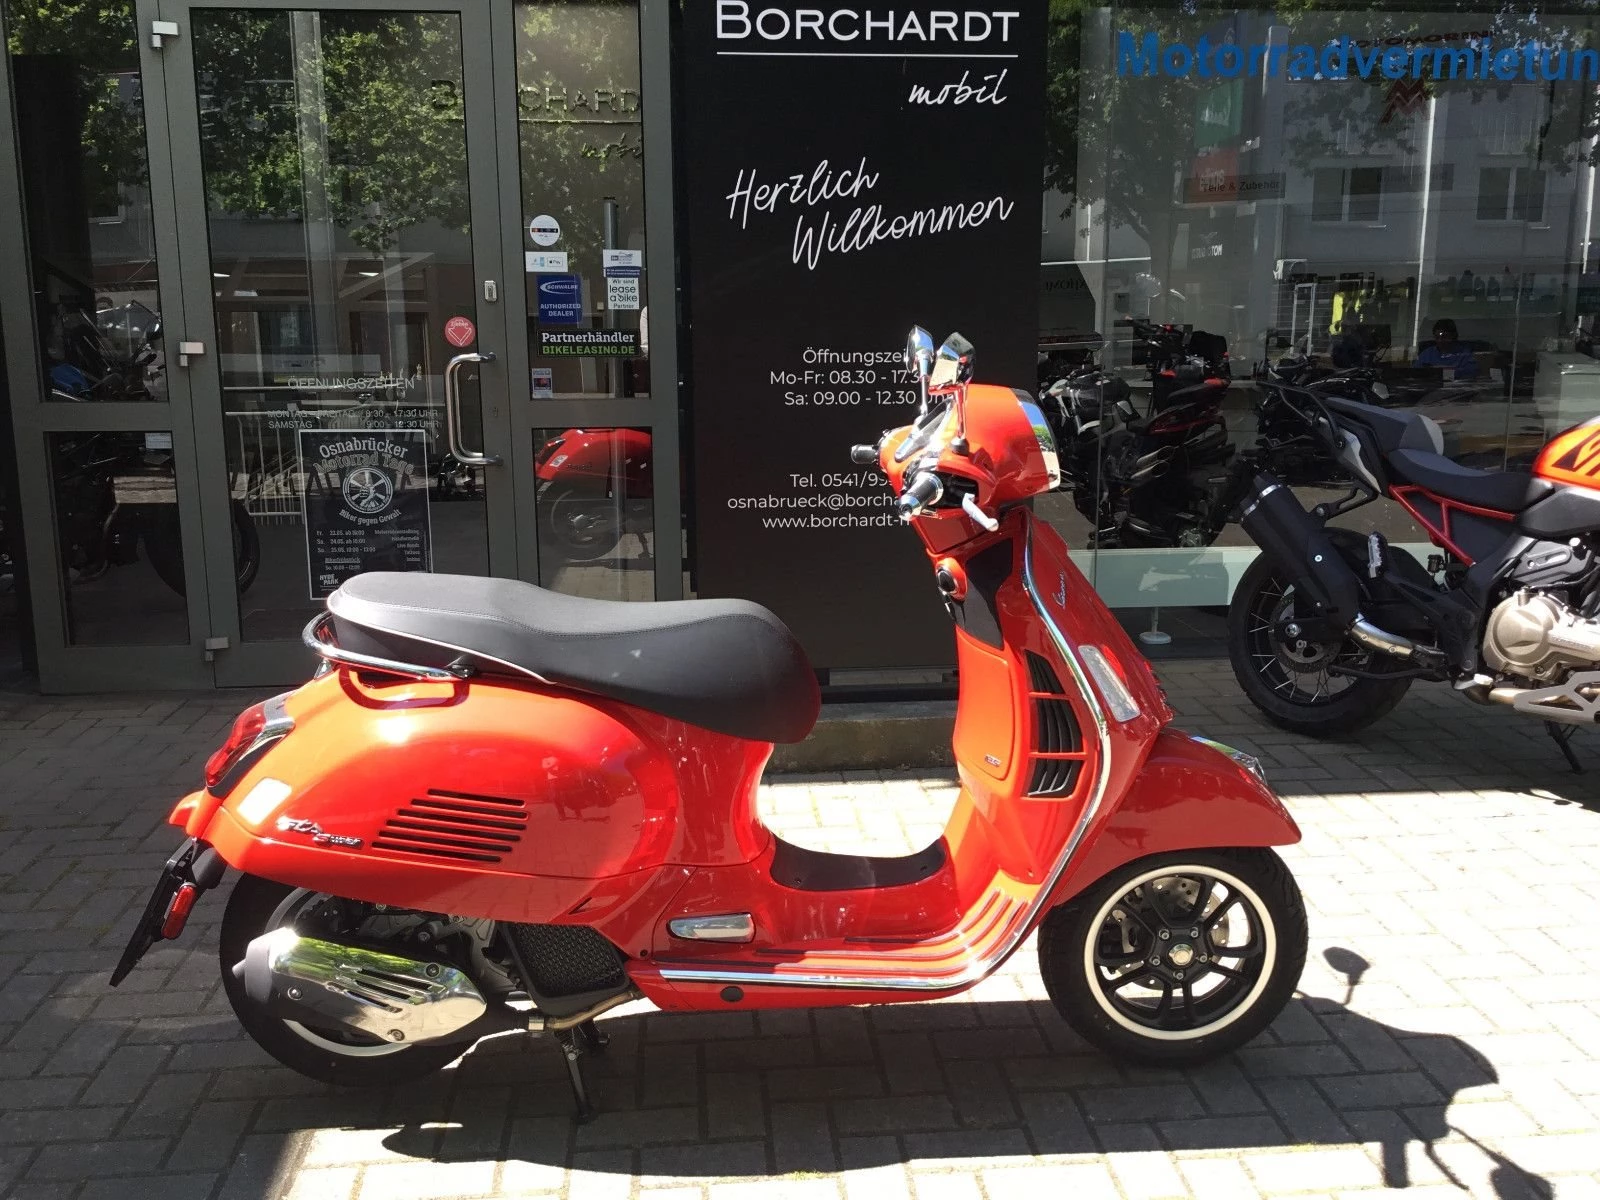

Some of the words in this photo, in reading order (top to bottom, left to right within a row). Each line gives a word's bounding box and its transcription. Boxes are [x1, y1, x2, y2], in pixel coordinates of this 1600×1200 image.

[717, 0, 1019, 41] BORCHARDT
[908, 69, 1008, 104] mobil
[726, 157, 879, 229] Herzlich
[793, 197, 1014, 270] Willkommen
[609, 284, 636, 294] lease
[542, 332, 634, 343] Partnerhändler
[543, 345, 635, 355] BIKELEASING.DE
[803, 347, 907, 366] Öffnungszei
[770, 371, 825, 384] Mo-Fr:
[829, 370, 876, 384] 08.30
[891, 370, 921, 384] 17.3
[784, 391, 809, 405] Sa:
[813, 391, 861, 405] 09.00
[875, 390, 917, 405] 12.30
[365, 410, 384, 418] 8:30
[419, 410, 438, 418] UHR
[268, 421, 313, 429] SAMSTAG
[366, 421, 385, 429] 9:00
[394, 421, 417, 429] 12:30
[320, 437, 408, 458] Osnabrücker
[313, 451, 379, 473] Motorrad
[382, 453, 415, 475] Tage
[790, 473, 817, 488] Tel.
[339, 509, 357, 524] Biker
[357, 518, 379, 526] gegen
[379, 509, 402, 523] Gewalt
